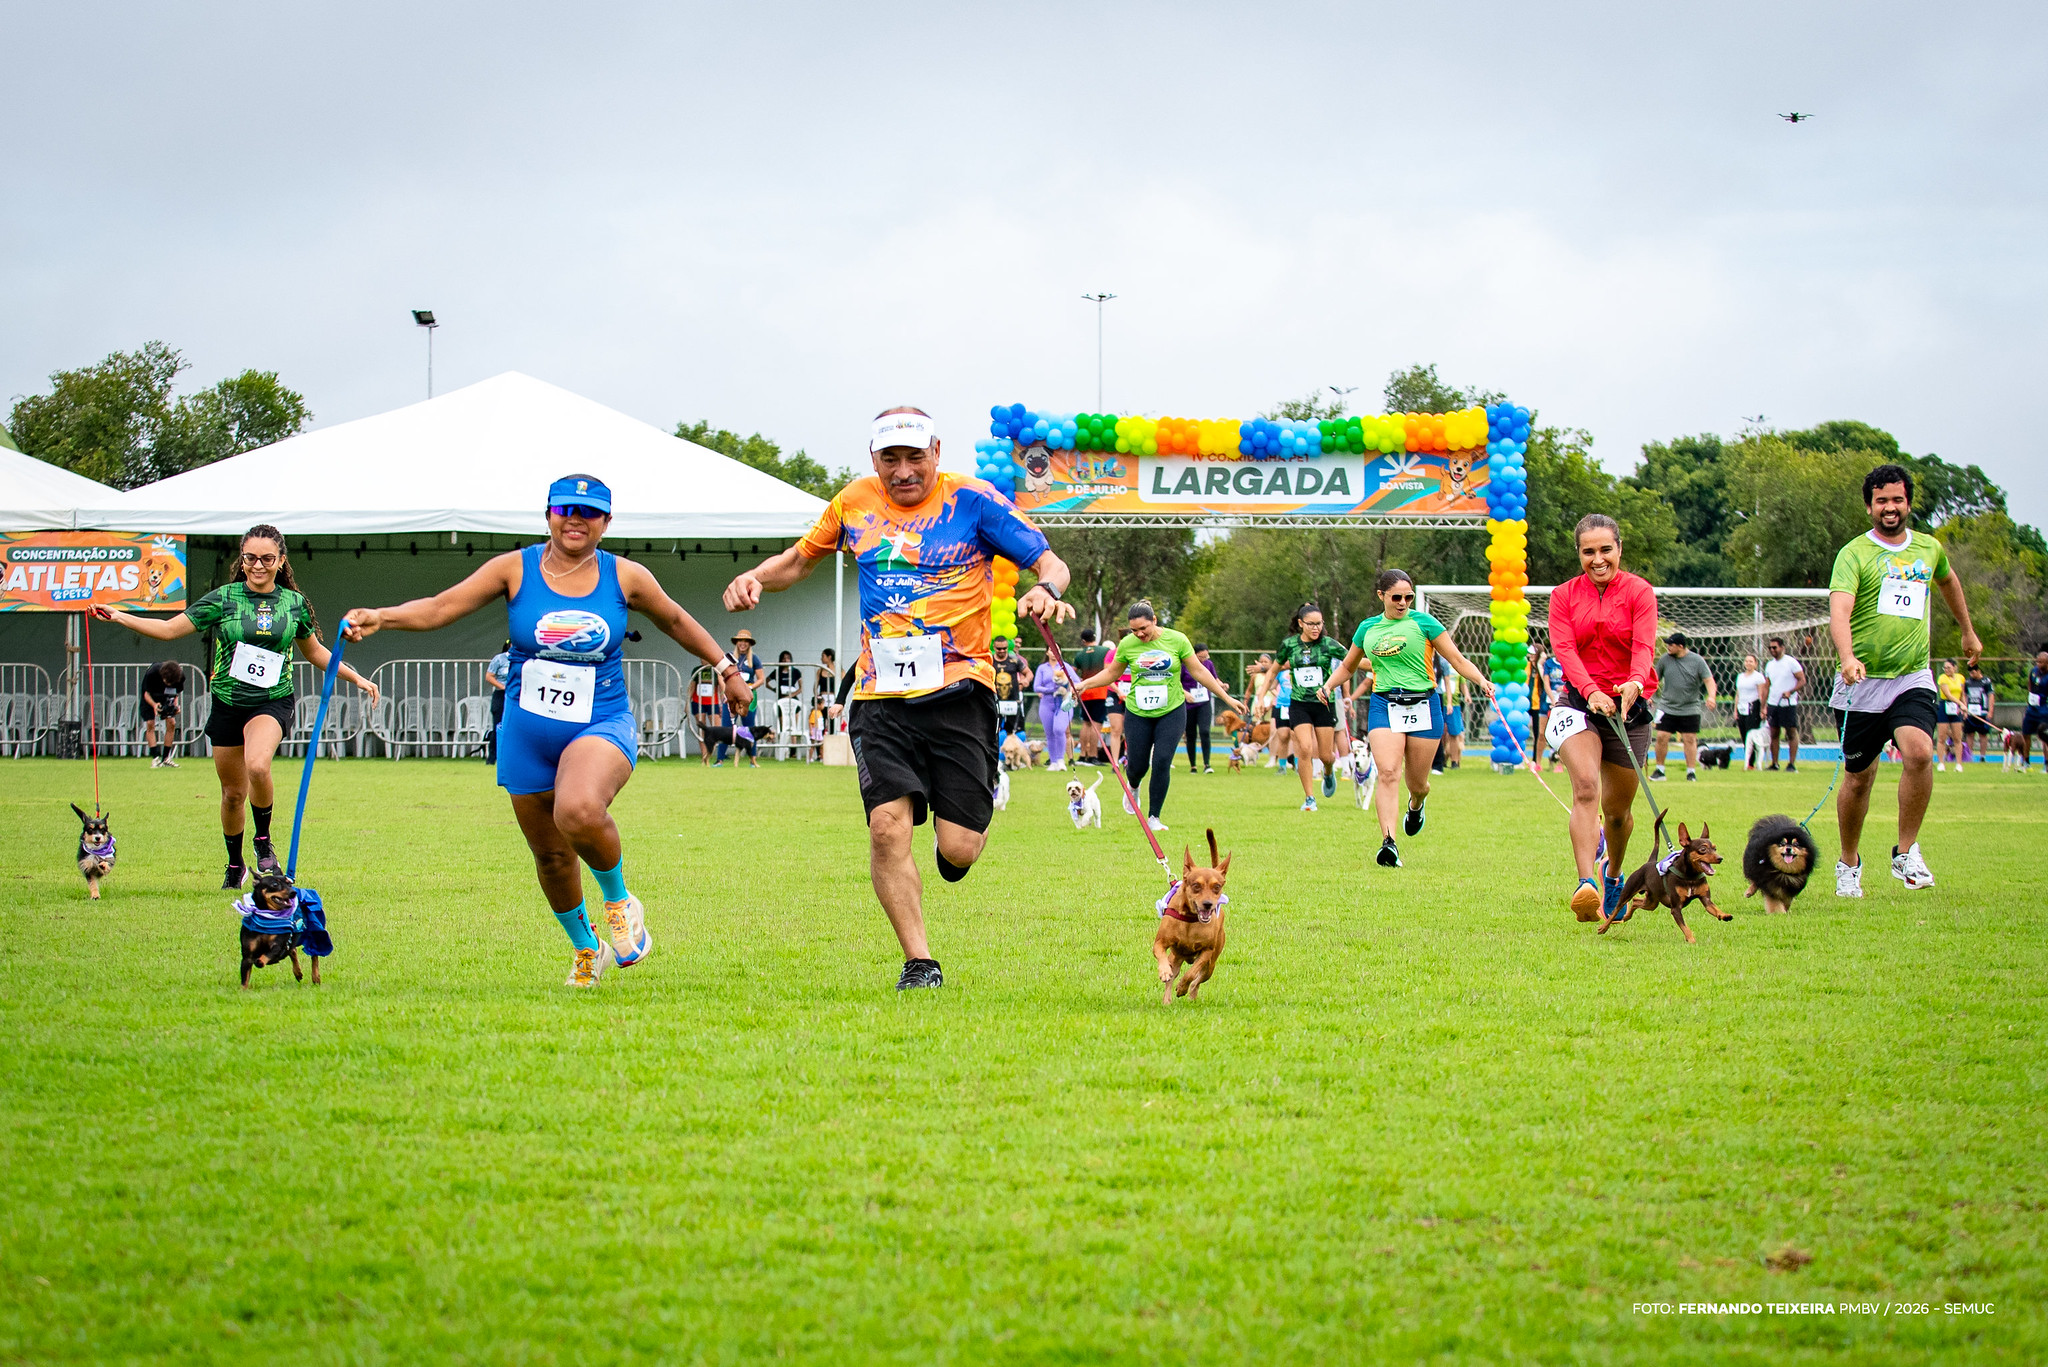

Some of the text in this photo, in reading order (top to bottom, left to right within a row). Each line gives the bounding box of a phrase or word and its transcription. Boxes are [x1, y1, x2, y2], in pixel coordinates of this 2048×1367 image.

[1152, 466, 1351, 496] LARGADA
[1066, 485, 1128, 495] 9 DE JULHO
[12, 548, 134, 562] CONCENTRAÇÃO DOS
[7, 565, 140, 592] ATLETAS
[64, 589, 83, 599] PET
[1894, 594, 1911, 606] 70
[248, 663, 265, 677] 63
[894, 661, 916, 677] 71
[537, 686, 575, 706] 179
[1143, 696, 1160, 704] 177
[1402, 714, 1418, 724] 75
[1553, 715, 1574, 736] 135
